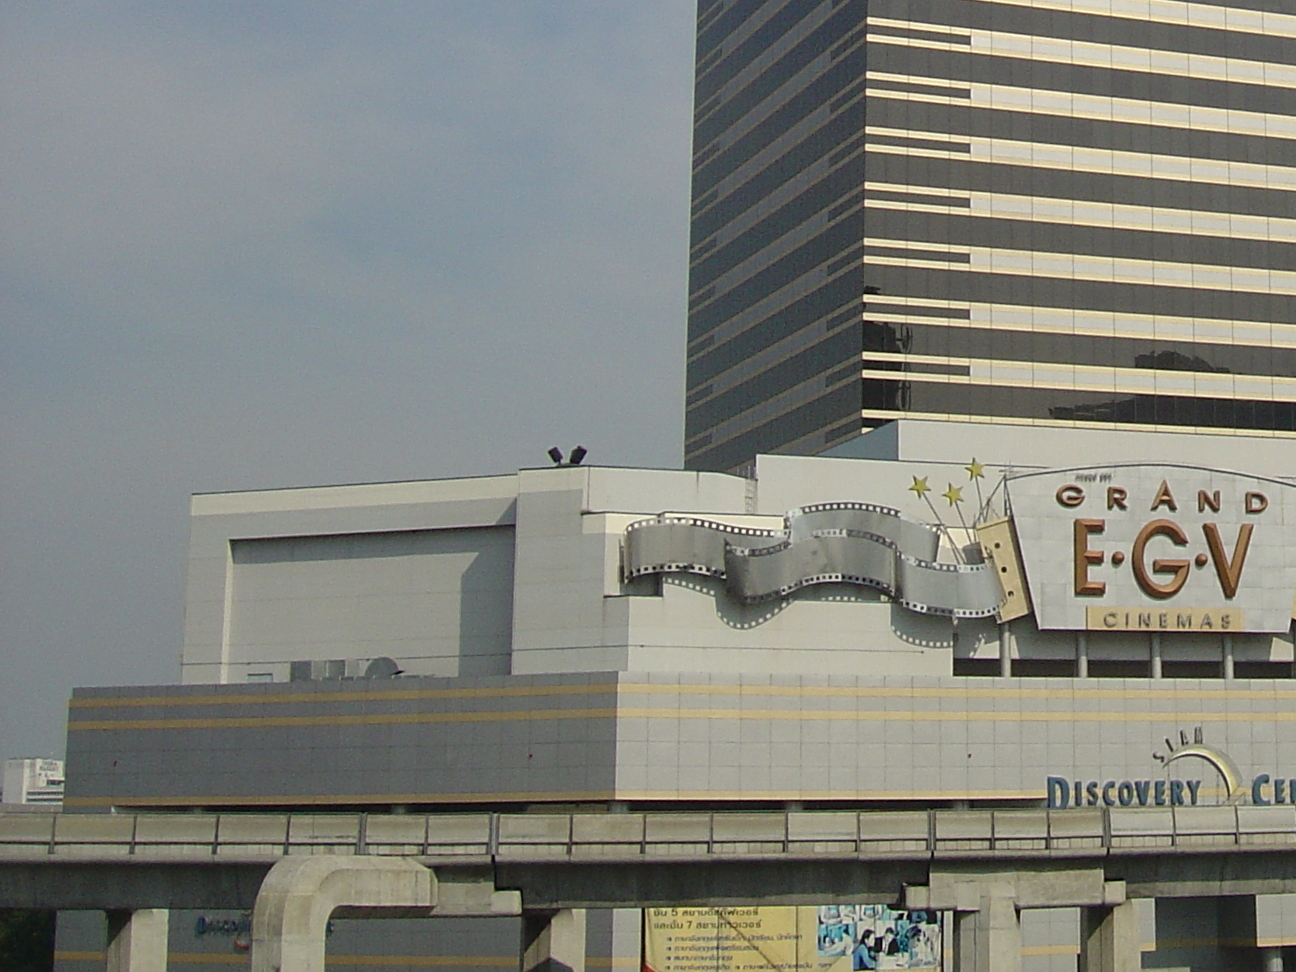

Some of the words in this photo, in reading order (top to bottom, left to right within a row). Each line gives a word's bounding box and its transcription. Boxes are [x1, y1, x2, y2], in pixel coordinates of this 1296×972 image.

[1056, 479, 1268, 514] GRAND
[1103, 611, 1231, 630] CINEMAS
[1152, 726, 1203, 763] SIAM
[686, 920, 693, 929] 7
